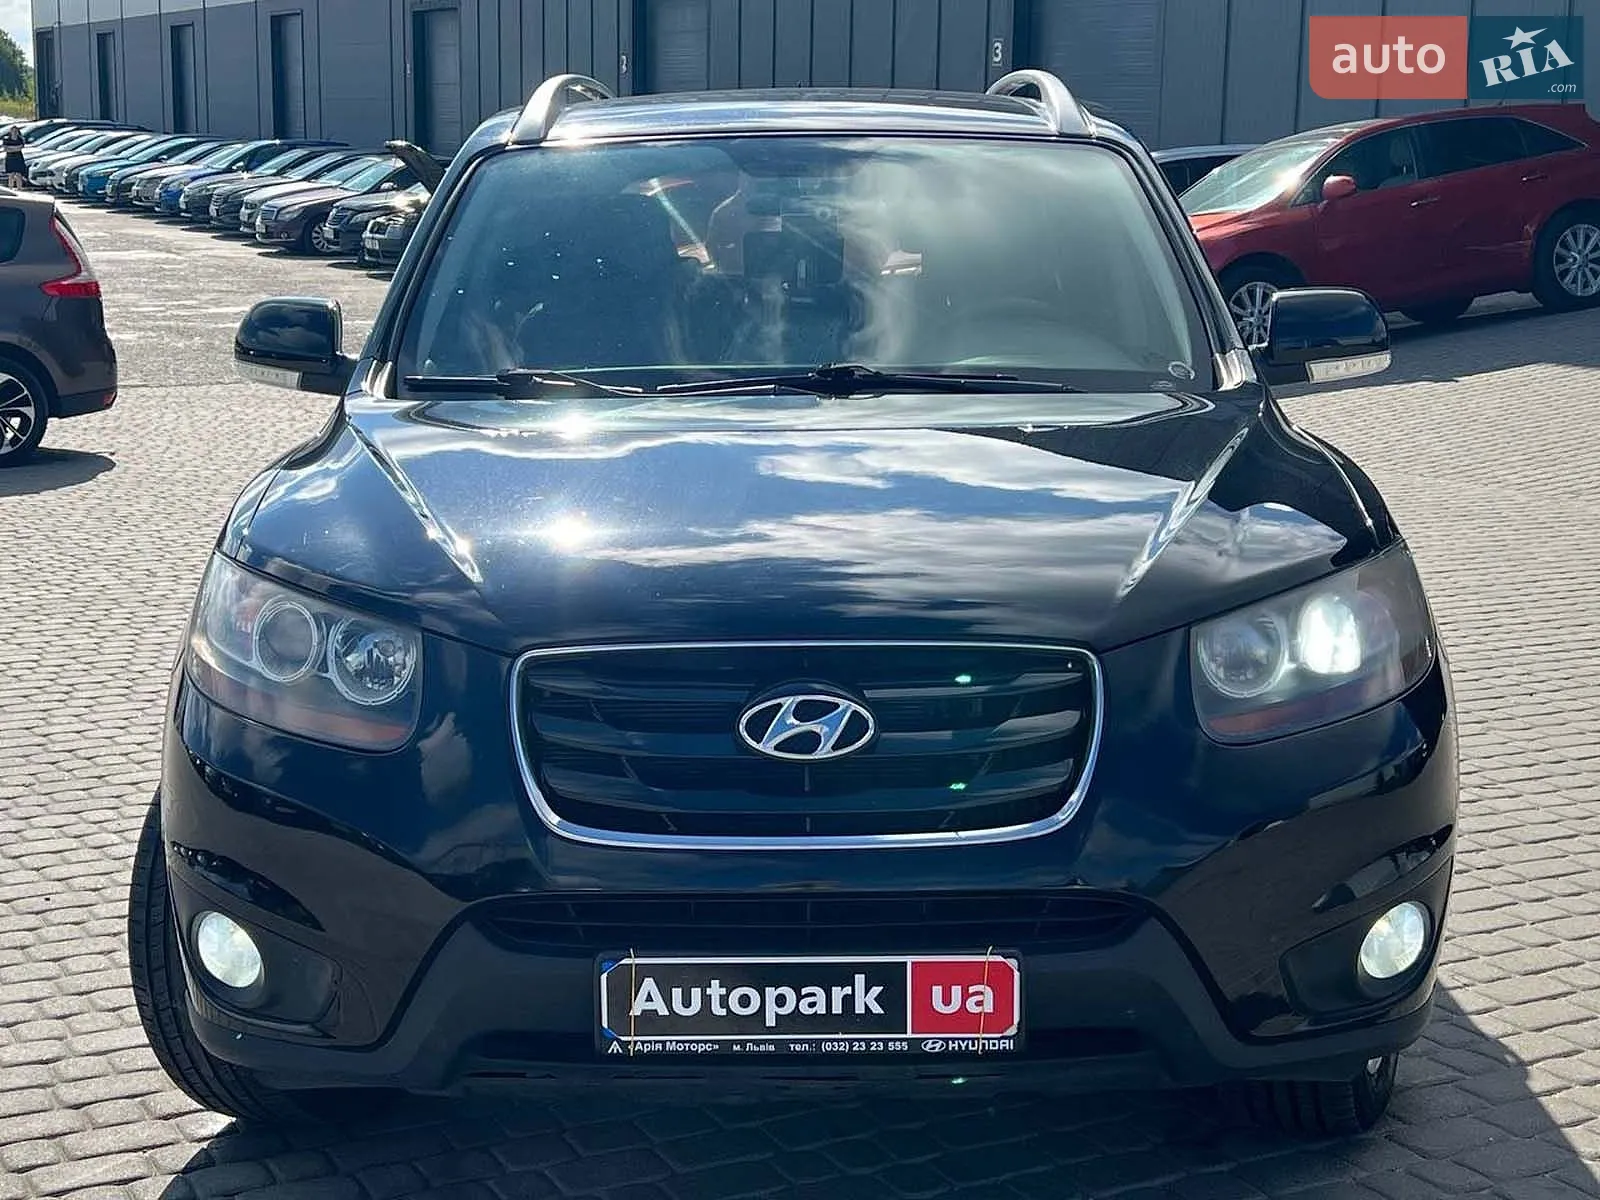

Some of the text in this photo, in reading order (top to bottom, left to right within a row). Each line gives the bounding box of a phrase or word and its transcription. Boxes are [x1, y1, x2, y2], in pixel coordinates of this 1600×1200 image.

[992, 42, 1002, 62] 3
[629, 974, 995, 1028] Autopark ua
[665, 1041, 719, 1053] Моторс»
[746, 1042, 776, 1052] Львів
[821, 1040, 849, 1052] (032)
[852, 1041, 866, 1051] 23
[870, 1041, 884, 1051] 23
[888, 1041, 909, 1051] 555
[948, 1040, 1014, 1051] HYUNDAI
